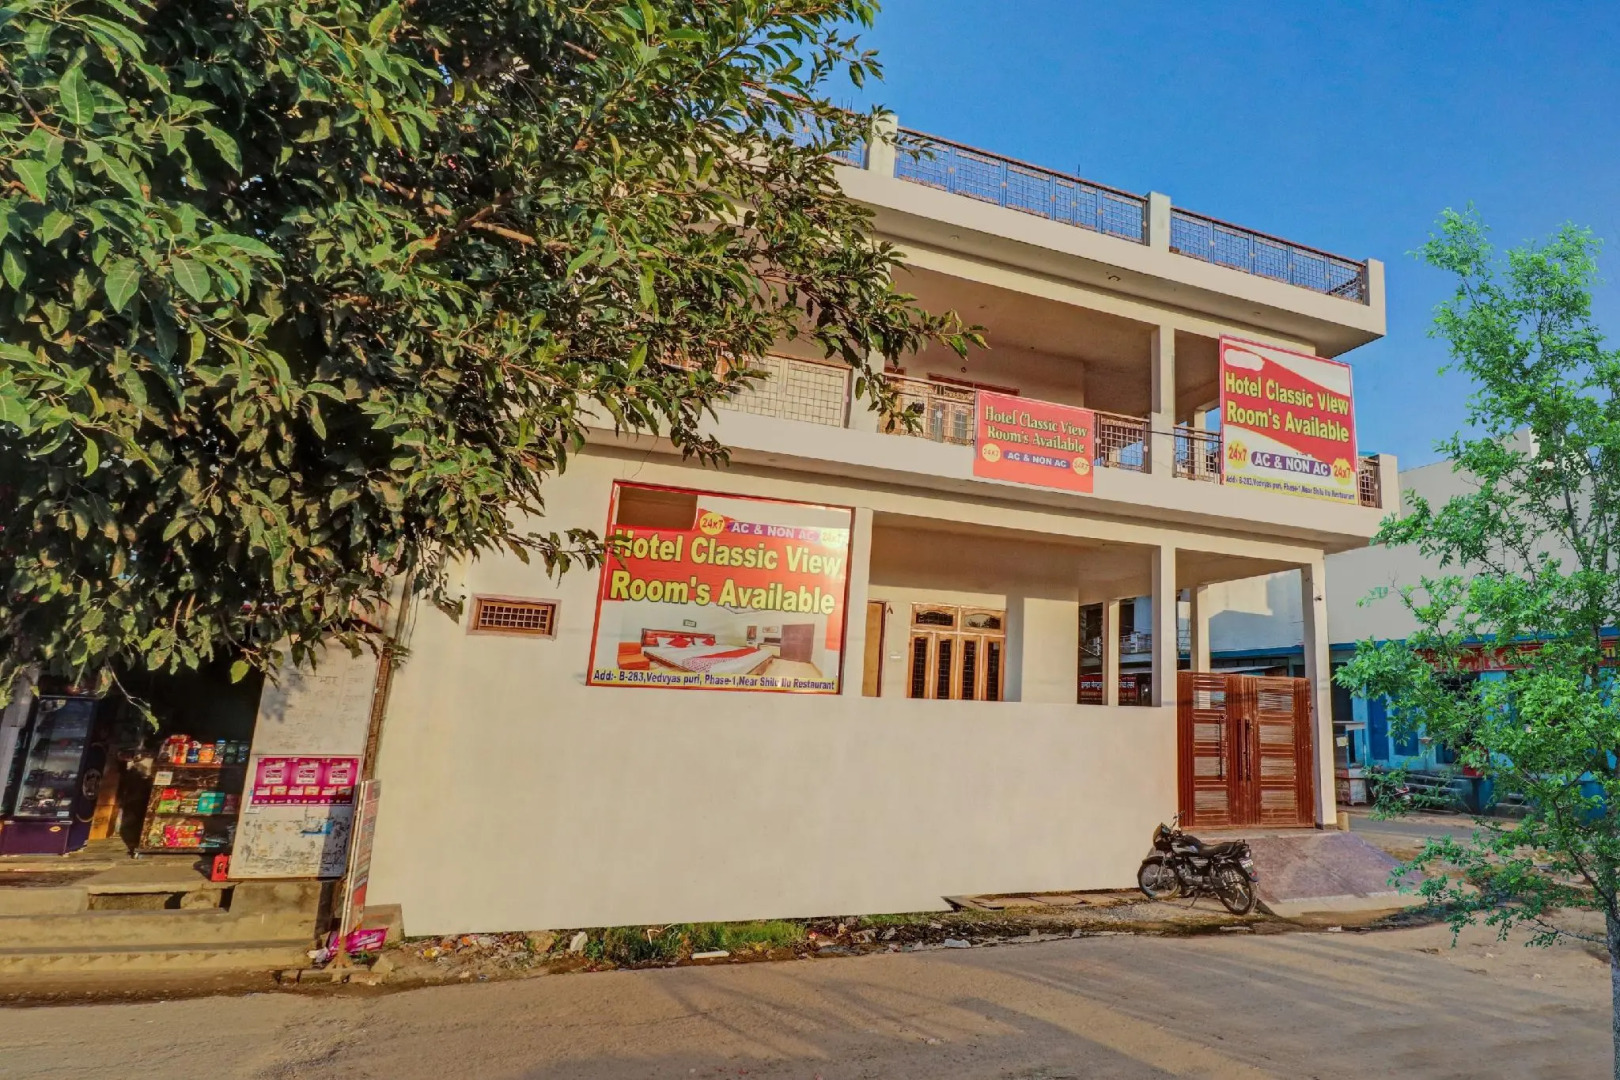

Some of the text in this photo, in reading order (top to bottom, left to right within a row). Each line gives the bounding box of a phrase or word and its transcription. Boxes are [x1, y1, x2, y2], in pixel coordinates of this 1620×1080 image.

[1225, 371, 1349, 416] Hotel Classic View
[985, 405, 1087, 437] Hotel Classic View
[1227, 400, 1349, 443] Room's Available
[987, 425, 1085, 453] Room's Available
[1007, 452, 1020, 460] AC
[1023, 454, 1030, 462] &
[1032, 456, 1052, 465] NON
[1054, 459, 1067, 468] AC
[1228, 444, 1247, 462] 24x7
[1255, 452, 1271, 467] AC
[1274, 455, 1283, 469] &
[1285, 457, 1310, 473] NON
[1313, 461, 1329, 476] AC
[702, 517, 724, 530] 24x7
[731, 522, 749, 534] AC
[754, 524, 763, 535] &
[767, 525, 794, 538] NON
[799, 530, 816, 541] AC
[690, 536, 779, 570] Classic
[785, 545, 842, 578] View
[609, 569, 836, 615] Room's Available
[793, 678, 835, 690] Restaurant
